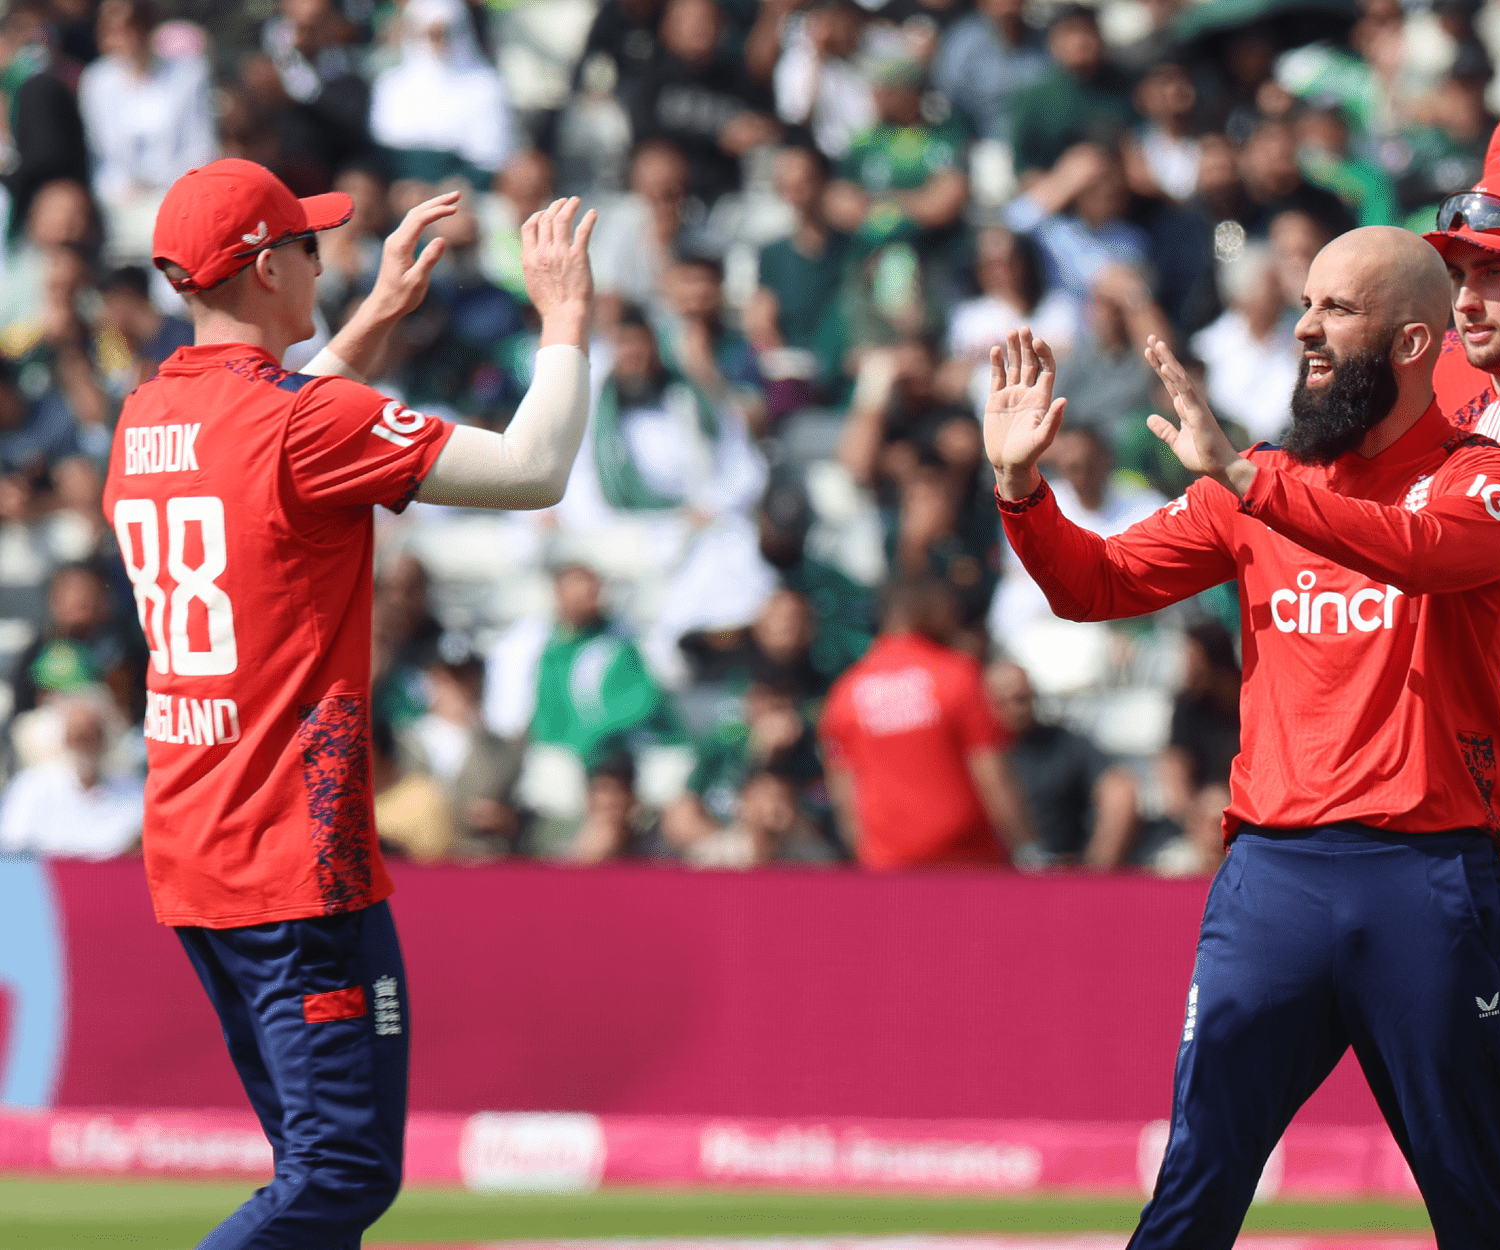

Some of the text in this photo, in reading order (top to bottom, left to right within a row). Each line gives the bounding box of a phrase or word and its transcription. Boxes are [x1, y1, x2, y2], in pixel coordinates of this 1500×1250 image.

[125, 422, 202, 476] BROOK
[370, 400, 426, 448] IG
[114, 496, 238, 677] 88
